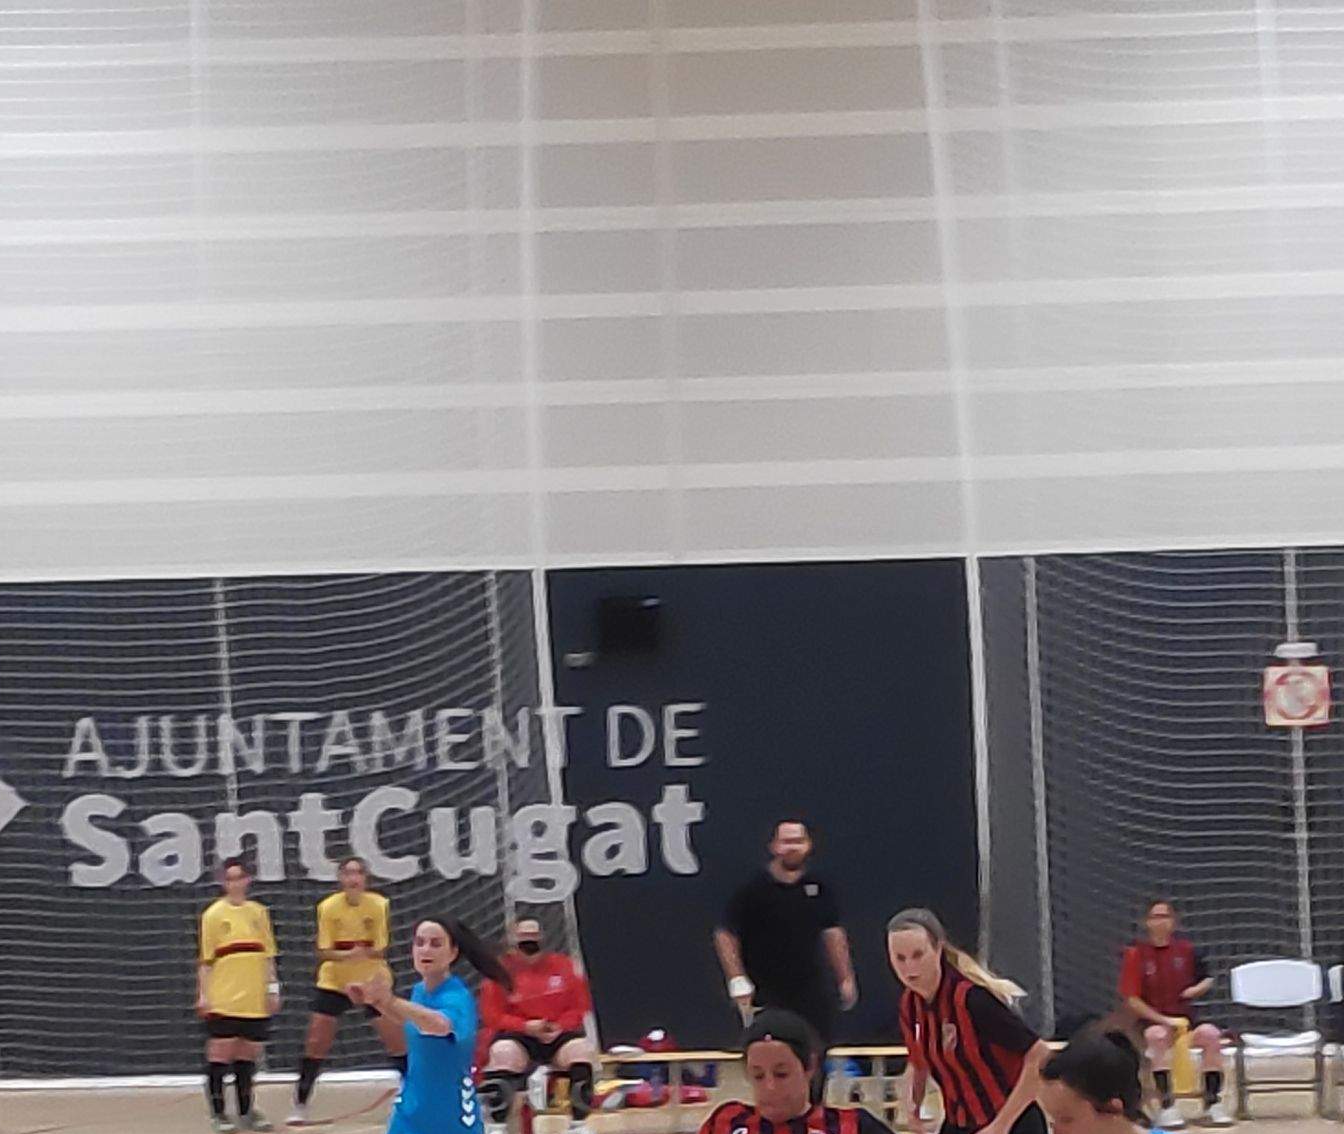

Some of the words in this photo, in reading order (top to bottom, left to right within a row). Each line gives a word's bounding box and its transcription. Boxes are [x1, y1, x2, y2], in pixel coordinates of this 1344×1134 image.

[61, 706, 584, 778] AJUNTAMENT
[608, 701, 708, 768] DE
[59, 784, 706, 904] SantCugat
